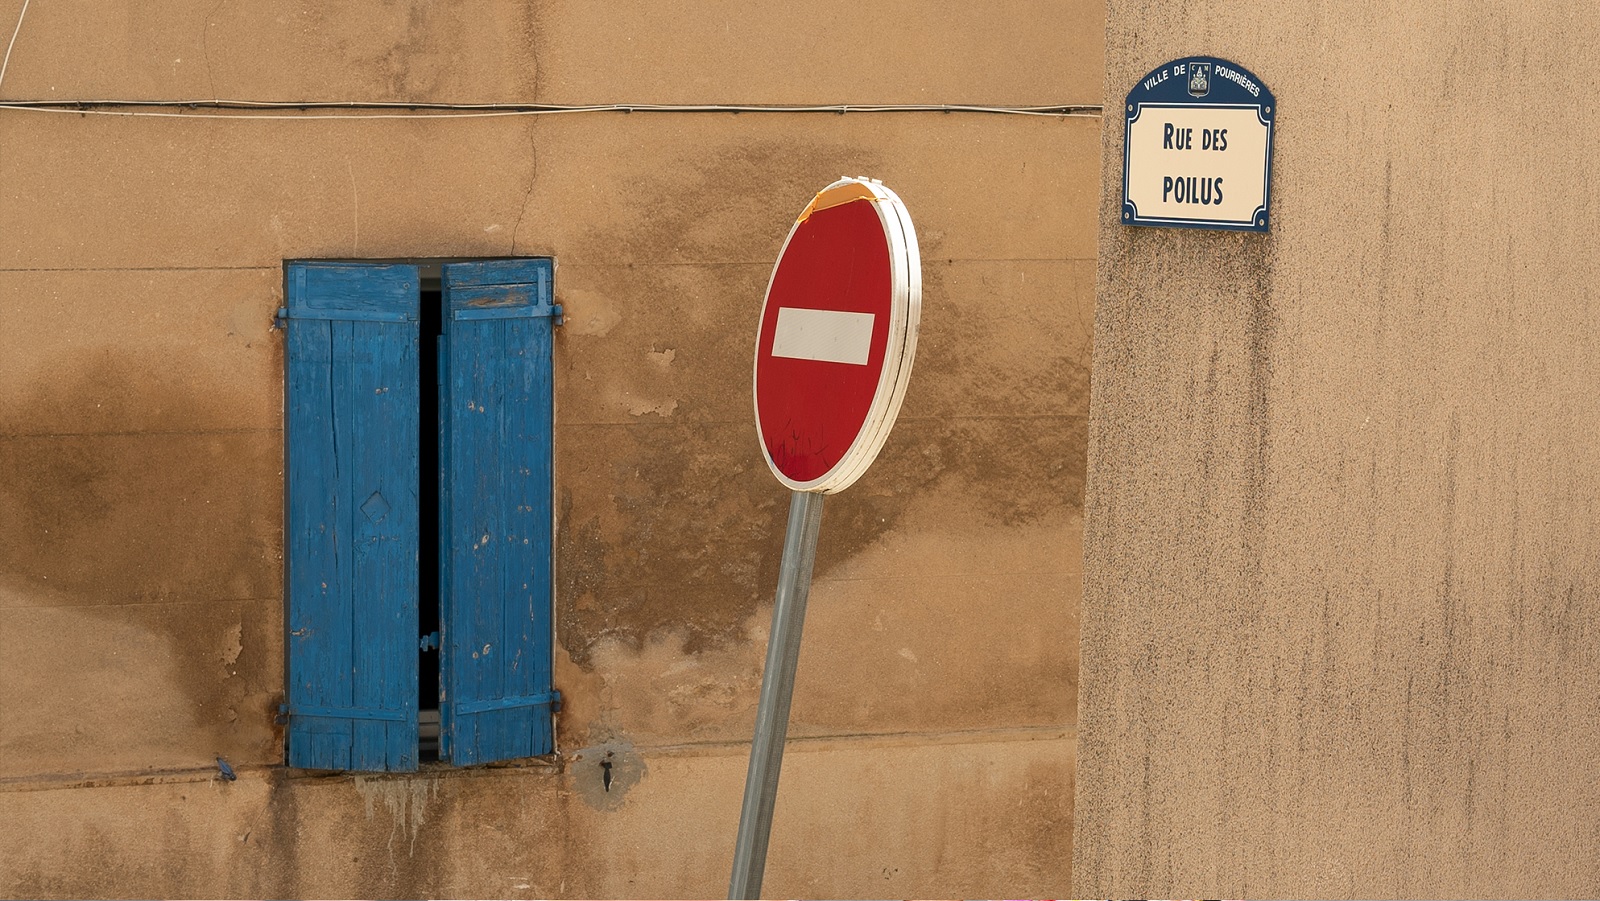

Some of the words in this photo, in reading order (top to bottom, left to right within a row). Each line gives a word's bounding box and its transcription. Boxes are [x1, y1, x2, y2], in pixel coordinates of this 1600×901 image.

[1144, 70, 1169, 91] VILLE
[1173, 64, 1186, 77] DE
[1214, 65, 1261, 98] POURRIÈRES
[1163, 122, 1193, 150] RUE
[1202, 128, 1228, 151] DES
[1162, 176, 1224, 205] POILUS
